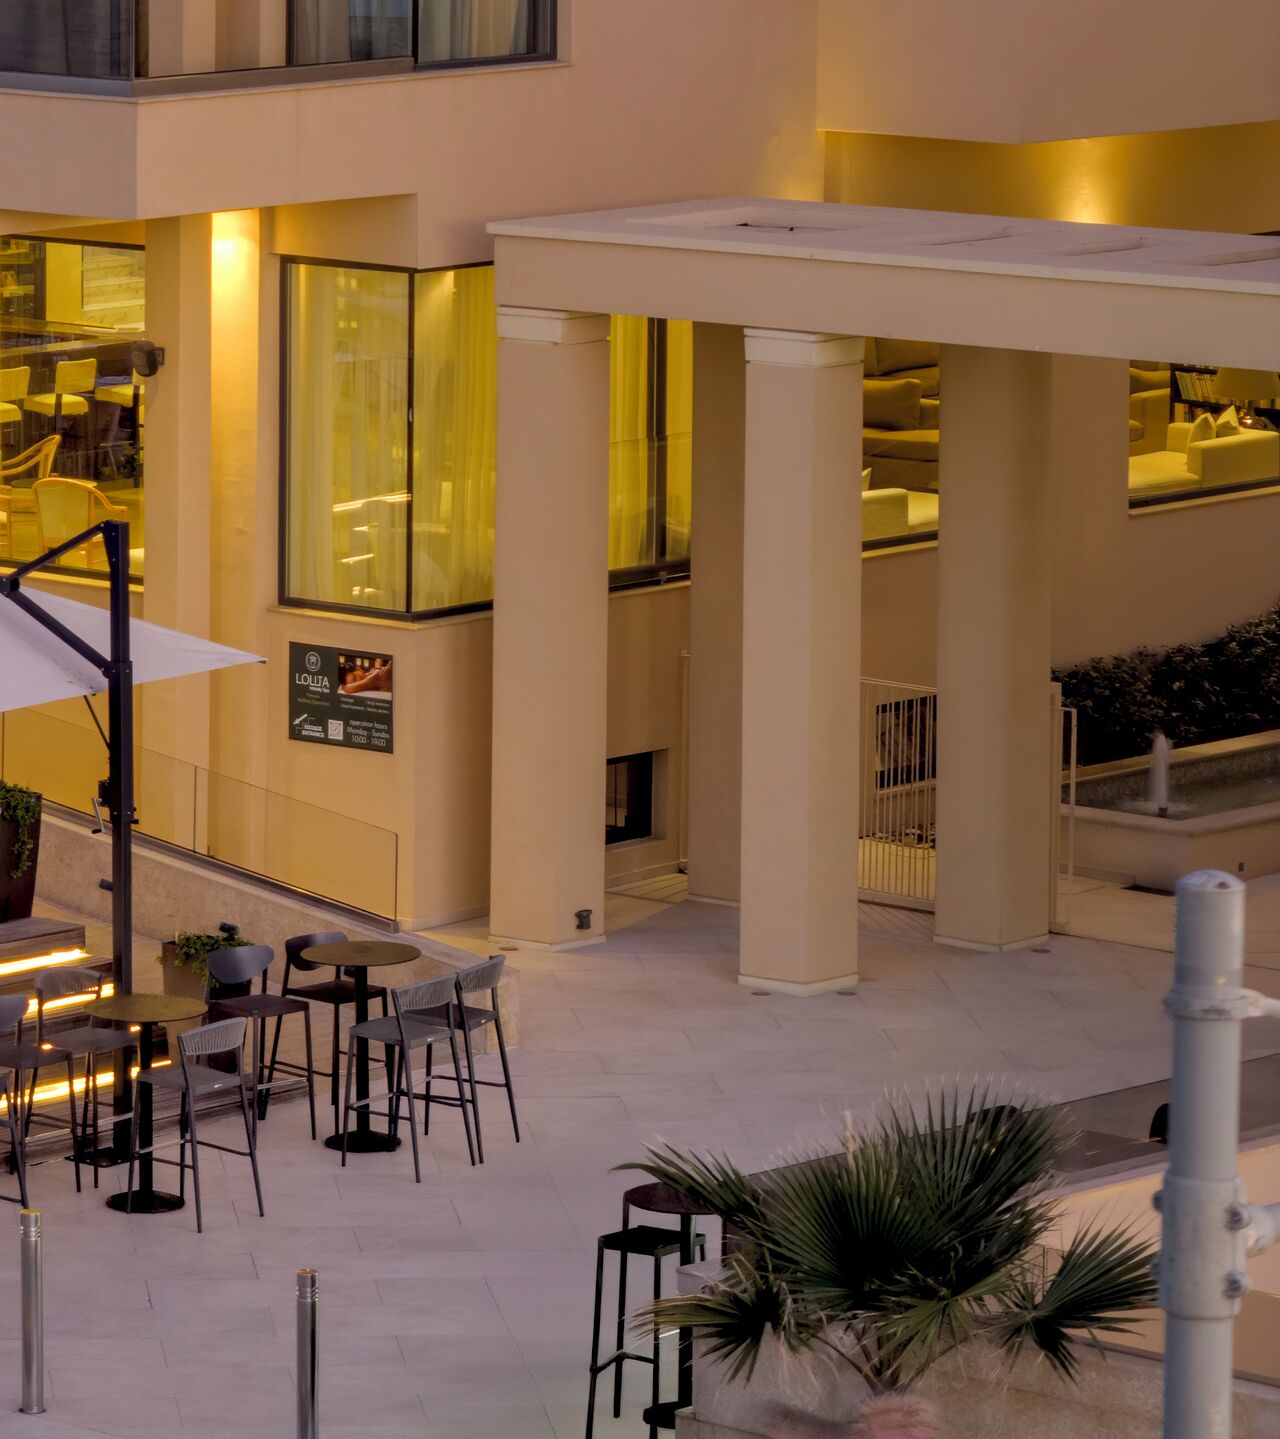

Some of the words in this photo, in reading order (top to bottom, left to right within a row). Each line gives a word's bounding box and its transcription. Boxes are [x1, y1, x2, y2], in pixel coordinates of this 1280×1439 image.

[295, 672, 330, 687] LOLITA
[349, 720, 373, 728] operation
[374, 721, 388, 730] hours
[347, 727, 368, 736] Monday
[371, 729, 390, 739] Sunday
